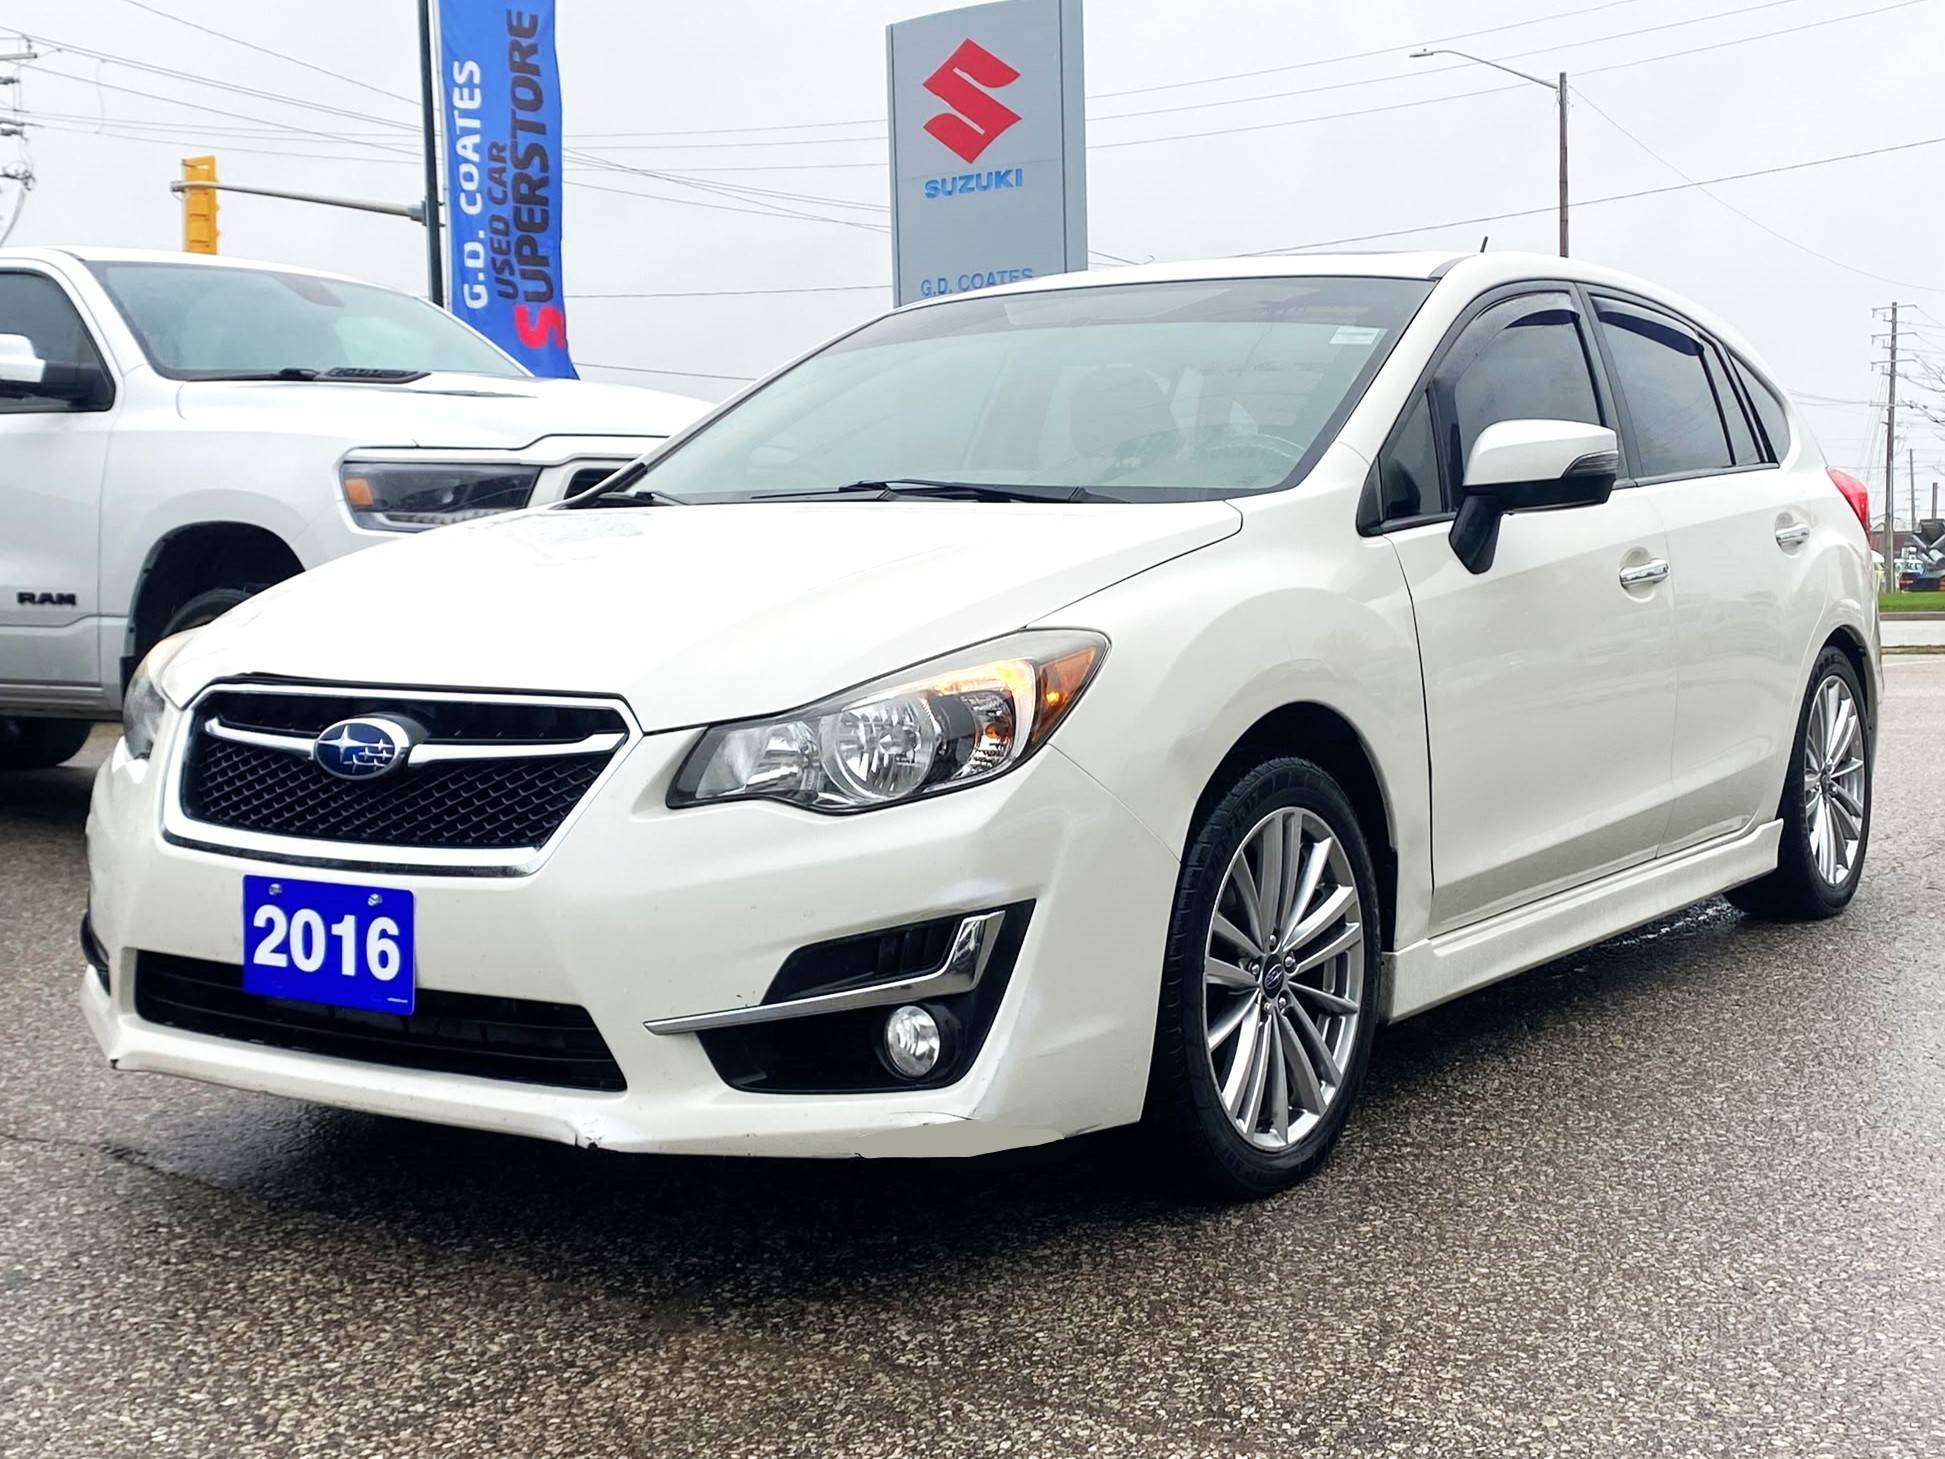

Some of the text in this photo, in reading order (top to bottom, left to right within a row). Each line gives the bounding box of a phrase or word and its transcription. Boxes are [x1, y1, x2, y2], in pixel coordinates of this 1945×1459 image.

[453, 59, 489, 310] G.D. COATES
[506, 9, 567, 349] SUPERSTORE
[924, 167, 1023, 199] SUZUKI
[487, 140, 519, 300] USED CAR
[920, 267, 1033, 297] G.D. COATES
[16, 592, 77, 606] RAM
[253, 904, 400, 981] 2016
